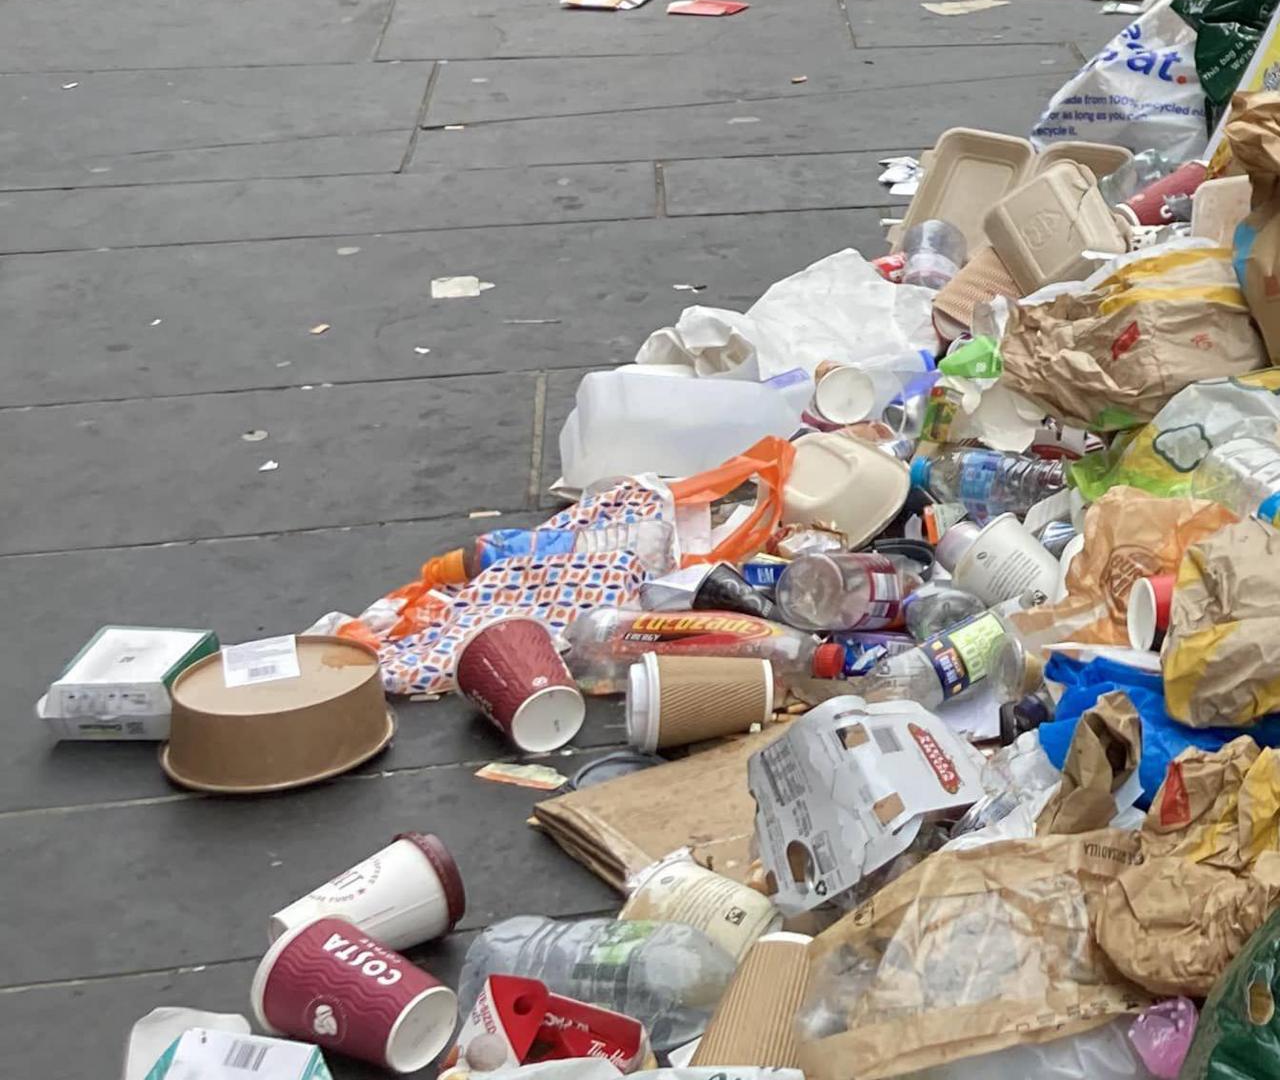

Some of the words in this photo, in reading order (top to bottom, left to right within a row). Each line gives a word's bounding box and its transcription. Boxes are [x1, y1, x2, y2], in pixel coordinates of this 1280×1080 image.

[1203, 66, 1220, 82] This
[1220, 50, 1236, 66] bag
[1236, 41, 1244, 51] is
[1064, 95, 1083, 106] ade
[1084, 95, 1107, 106] from
[1062, 112, 1073, 120] as
[1075, 110, 1095, 122] long
[1096, 112, 1107, 120] as
[1108, 112, 1126, 123] you
[1068, 126, 1078, 137] it.
[322, 933, 403, 986] COSTA
